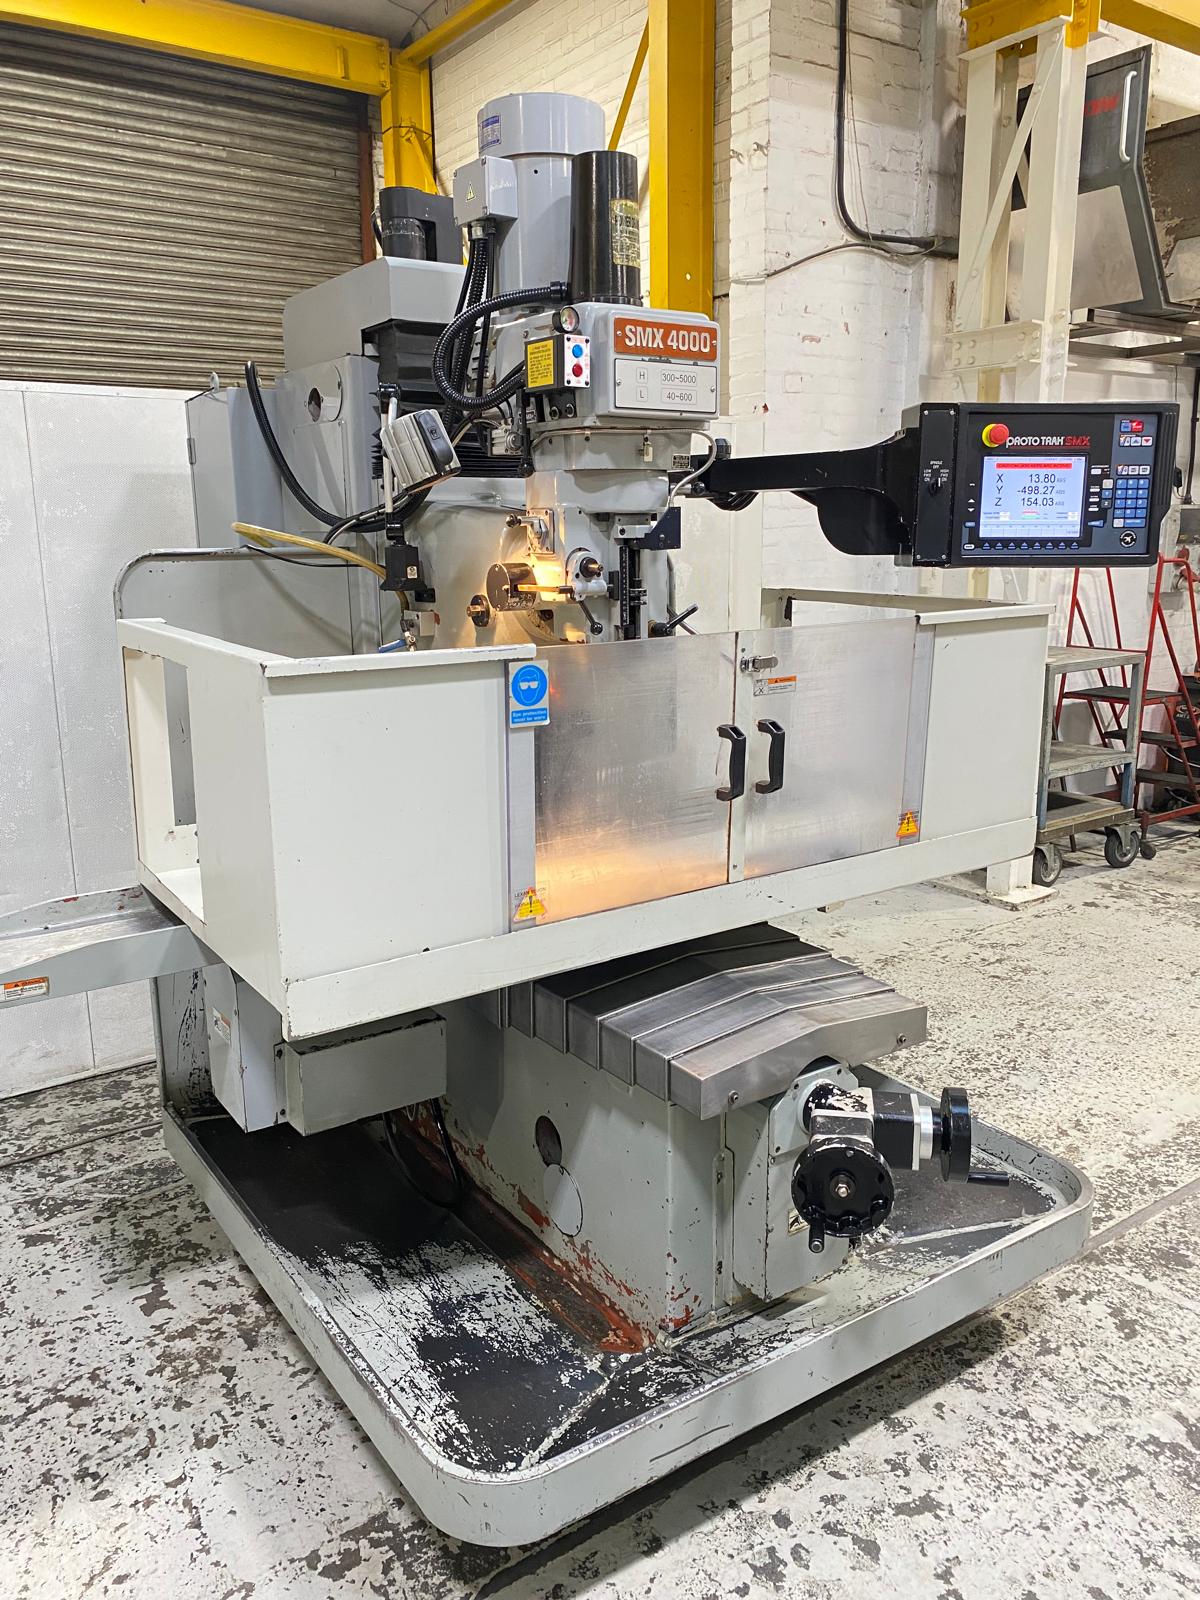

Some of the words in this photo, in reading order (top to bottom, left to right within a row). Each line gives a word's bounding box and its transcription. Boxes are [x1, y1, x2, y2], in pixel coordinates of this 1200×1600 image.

[625, 325, 664, 349] SMX
[667, 330, 710, 353] 4000
[639, 371, 645, 380] H
[662, 373, 697, 384] 300~5000
[639, 390, 645, 399] L
[666, 392, 693, 402] 40~600
[1065, 436, 1090, 446] SMX
[996, 474, 1004, 483] X
[1029, 474, 1056, 483] 13.80
[996, 486, 1003, 494] Y
[1017, 486, 1055, 495] -498.27
[995, 498, 1002, 506] Z
[1021, 498, 1054, 506] 154.03
